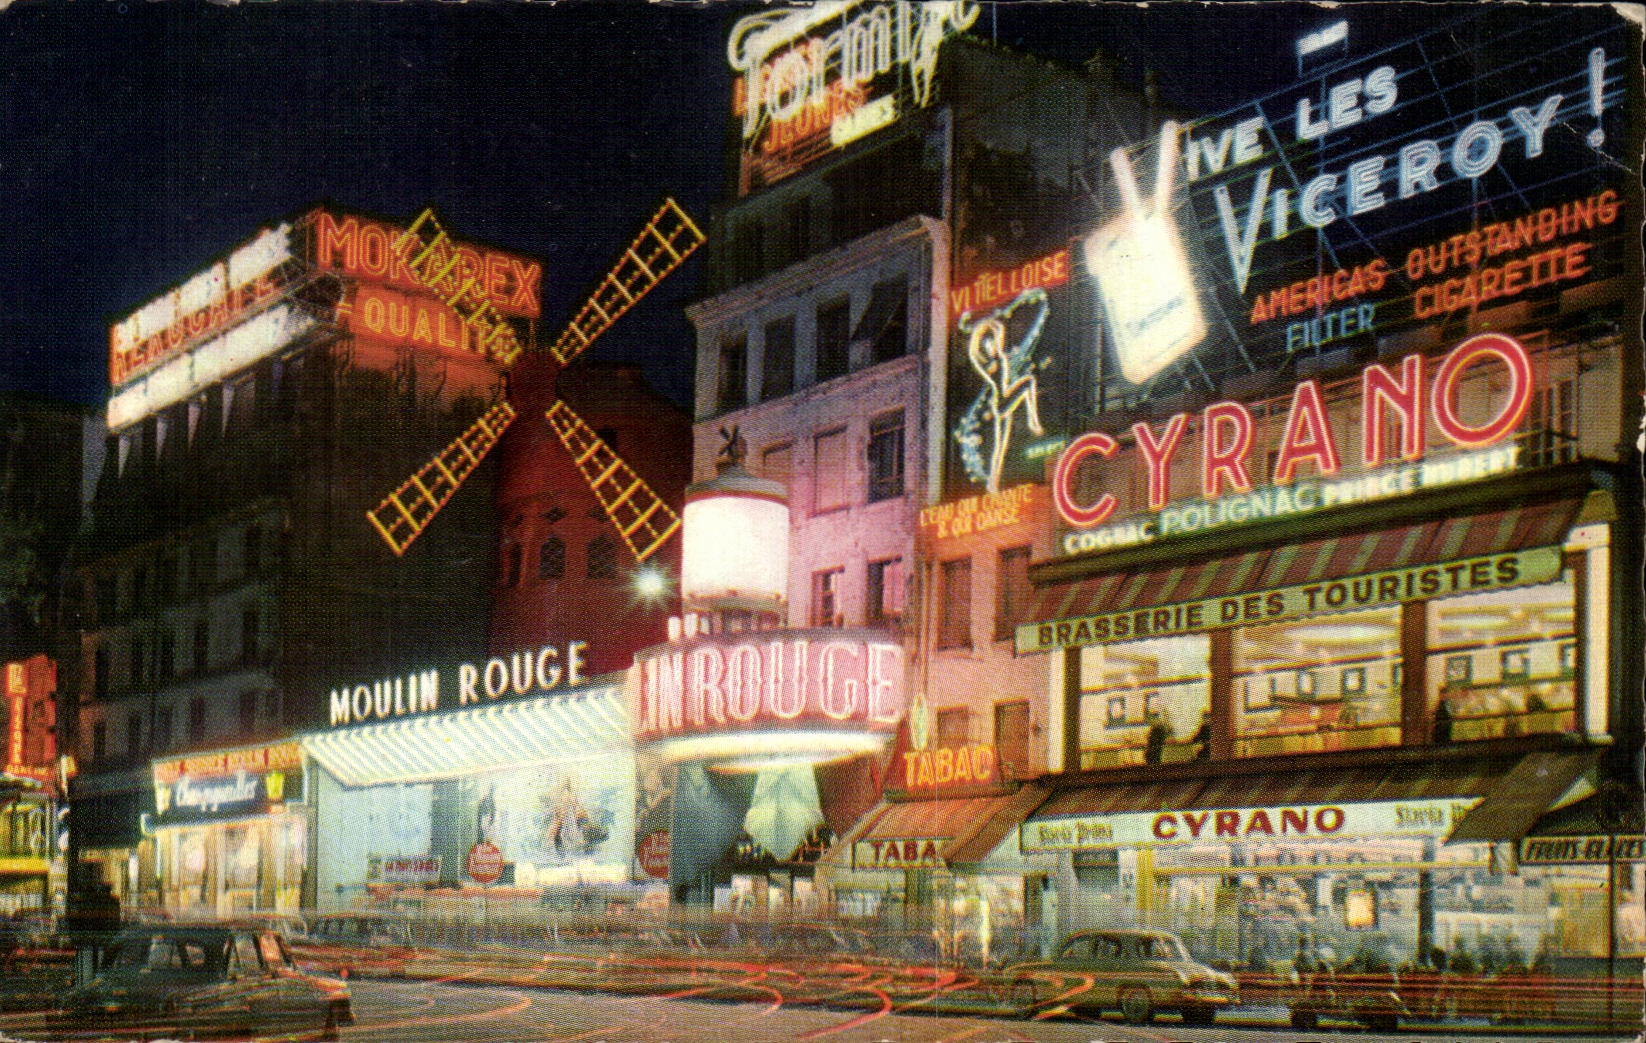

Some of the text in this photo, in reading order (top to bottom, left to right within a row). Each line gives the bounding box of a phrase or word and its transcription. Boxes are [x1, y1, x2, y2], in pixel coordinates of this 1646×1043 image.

[1297, 65, 1399, 142] LES
[1212, 94, 1564, 294] VICEROY
[1404, 189, 1621, 281] OUTSTANDING
[317, 211, 542, 315] MOKAREX
[1286, 241, 1592, 354] FILTER CIGARETTE
[1053, 332, 1534, 528] CYRANO
[1063, 520, 1156, 554] COGNAC
[1158, 482, 1320, 536] POLIGNAC
[1038, 556, 1520, 647] BRASSERIE DES TOURISTES
[329, 640, 590, 725] MOULIN ROUGE
[904, 744, 993, 788] TABAC
[1152, 807, 1347, 840] CYRANO
